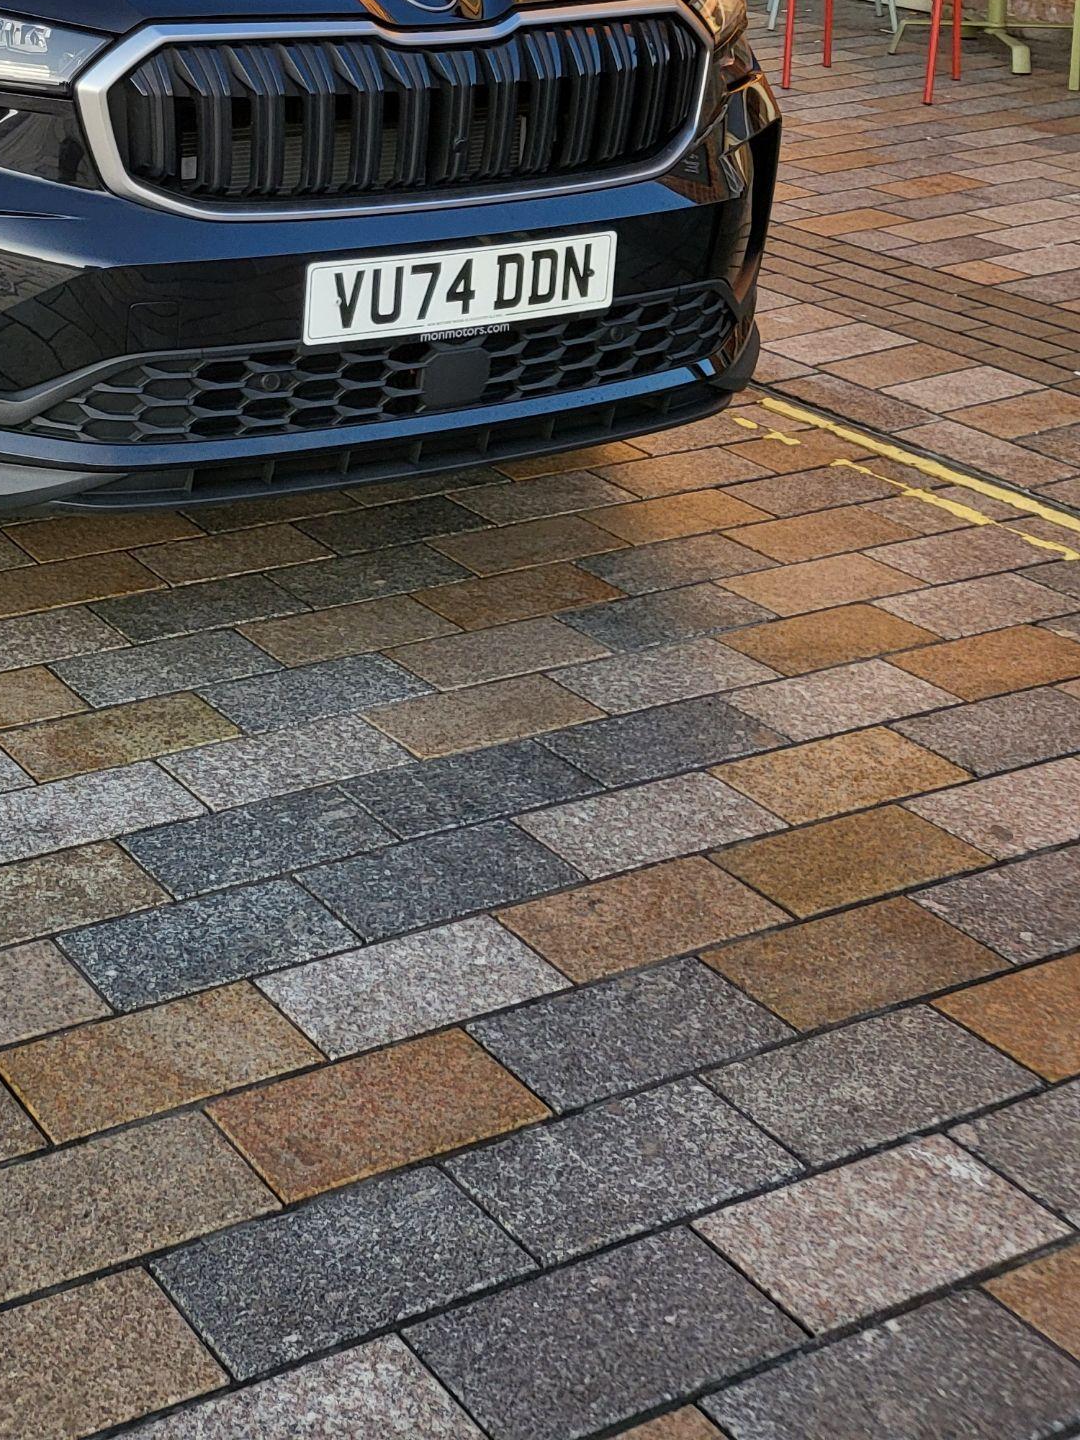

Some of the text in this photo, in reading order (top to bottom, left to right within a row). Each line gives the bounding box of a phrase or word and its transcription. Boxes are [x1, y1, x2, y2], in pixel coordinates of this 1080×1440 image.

[333, 243, 593, 329] VU74 DDN
[420, 323, 510, 342] monmotors.com
